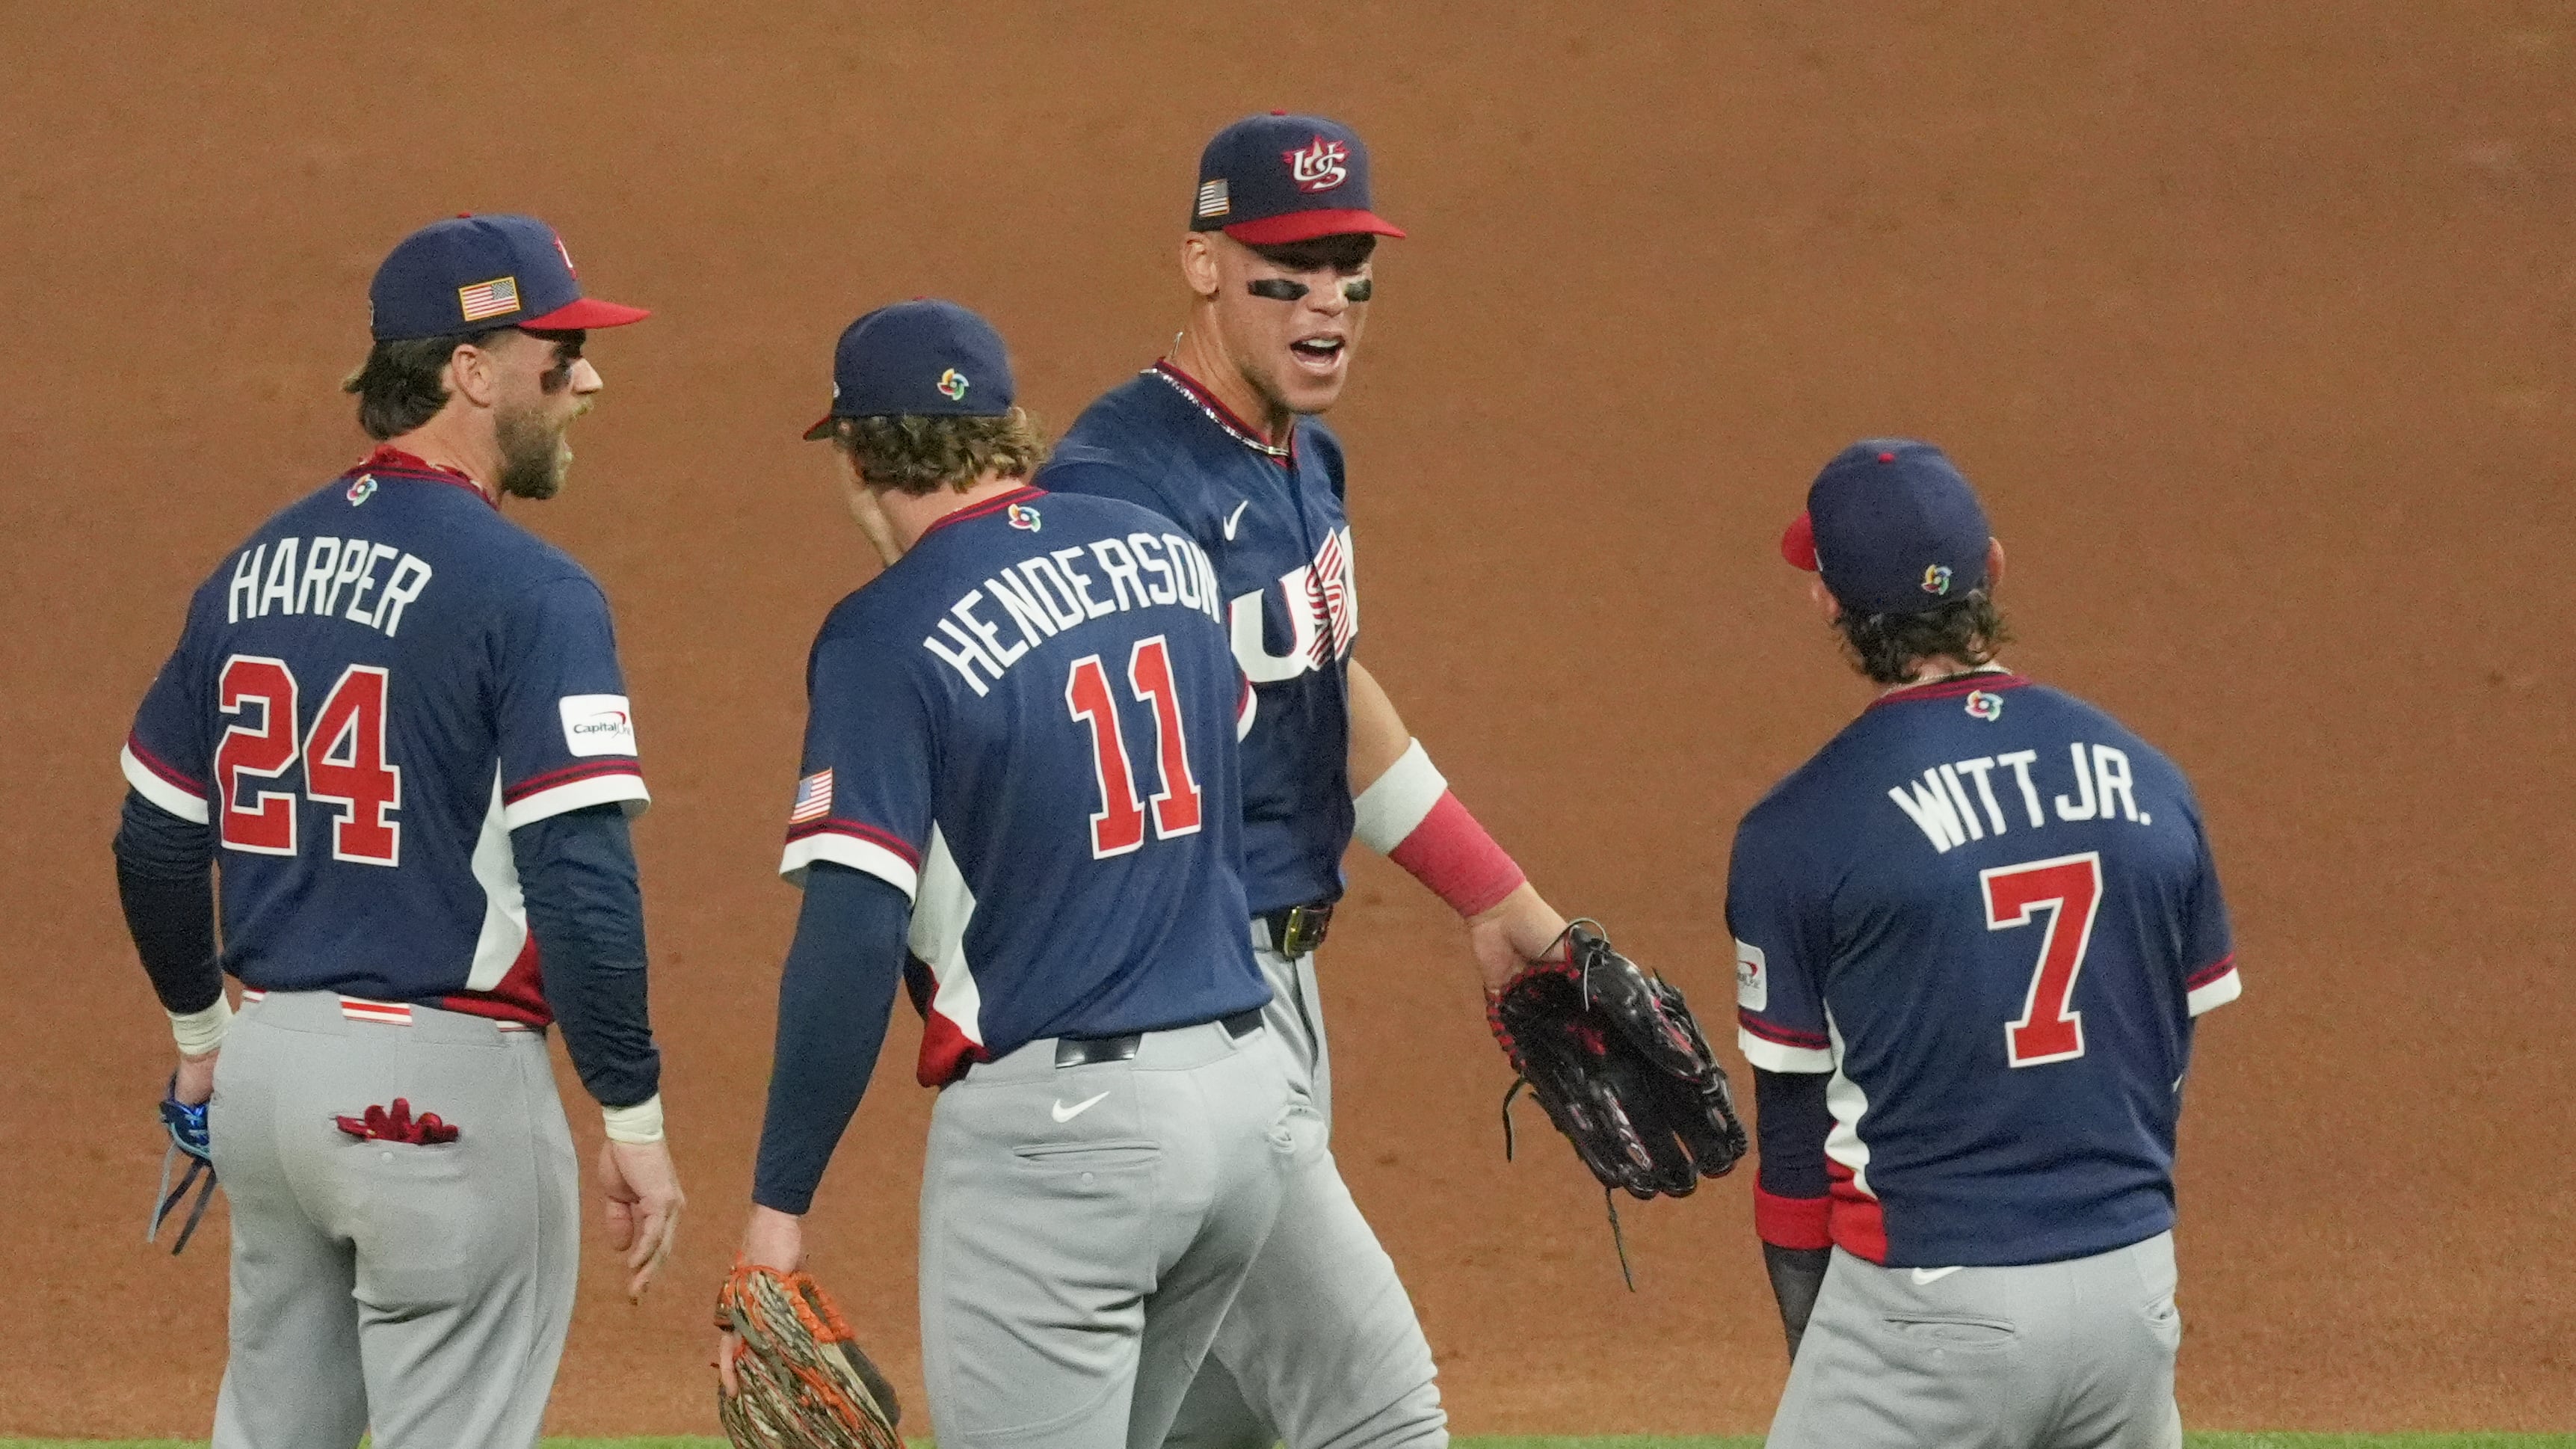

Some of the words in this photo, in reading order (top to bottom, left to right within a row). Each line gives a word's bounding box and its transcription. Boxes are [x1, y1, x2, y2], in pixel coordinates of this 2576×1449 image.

[228, 537, 432, 636] HARPER
[923, 532, 1221, 697] HENDERSON
[215, 654, 400, 867] 24
[1064, 635, 1201, 860] 11
[1888, 749, 2044, 853] WITT
[2054, 742, 2151, 825] JR.
[1979, 851, 2103, 1068] 7
